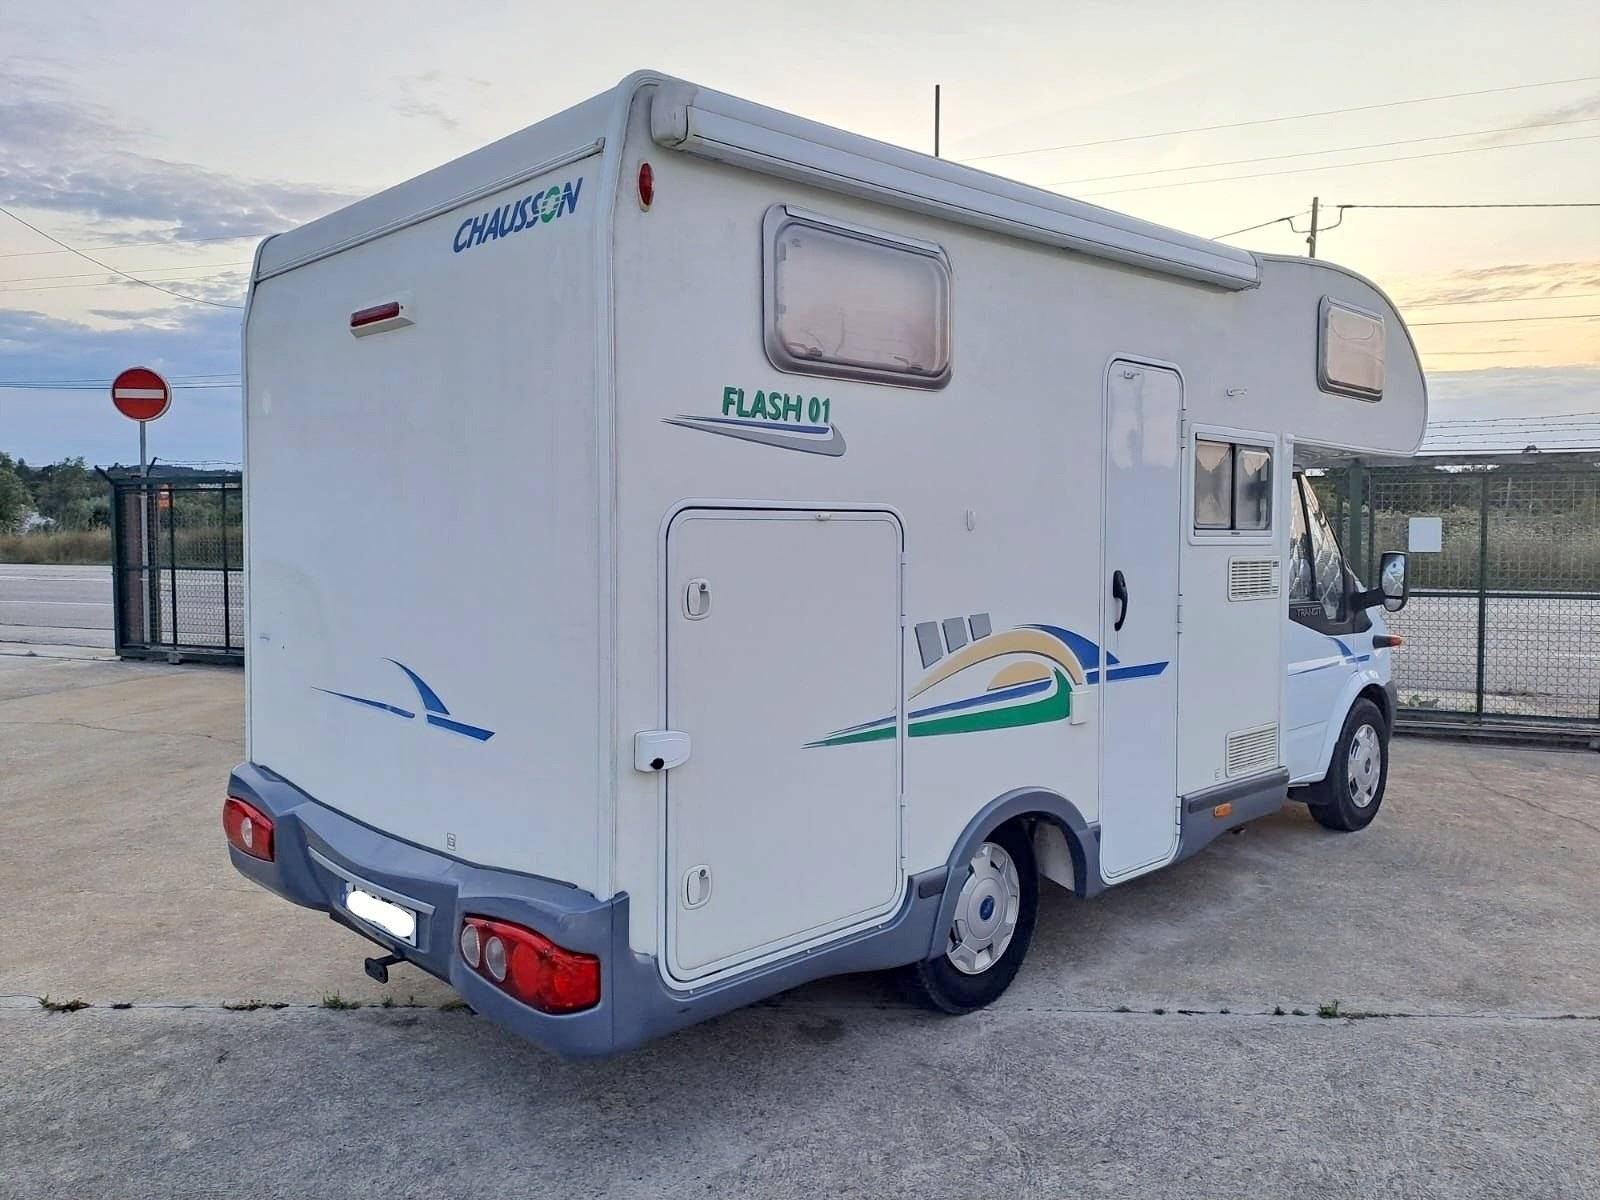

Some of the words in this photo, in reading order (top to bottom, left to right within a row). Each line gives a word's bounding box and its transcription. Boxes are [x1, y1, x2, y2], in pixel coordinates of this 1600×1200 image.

[453, 177, 583, 253] CHAUSSON
[721, 386, 802, 422] FLASH
[808, 397, 830, 423] 01
